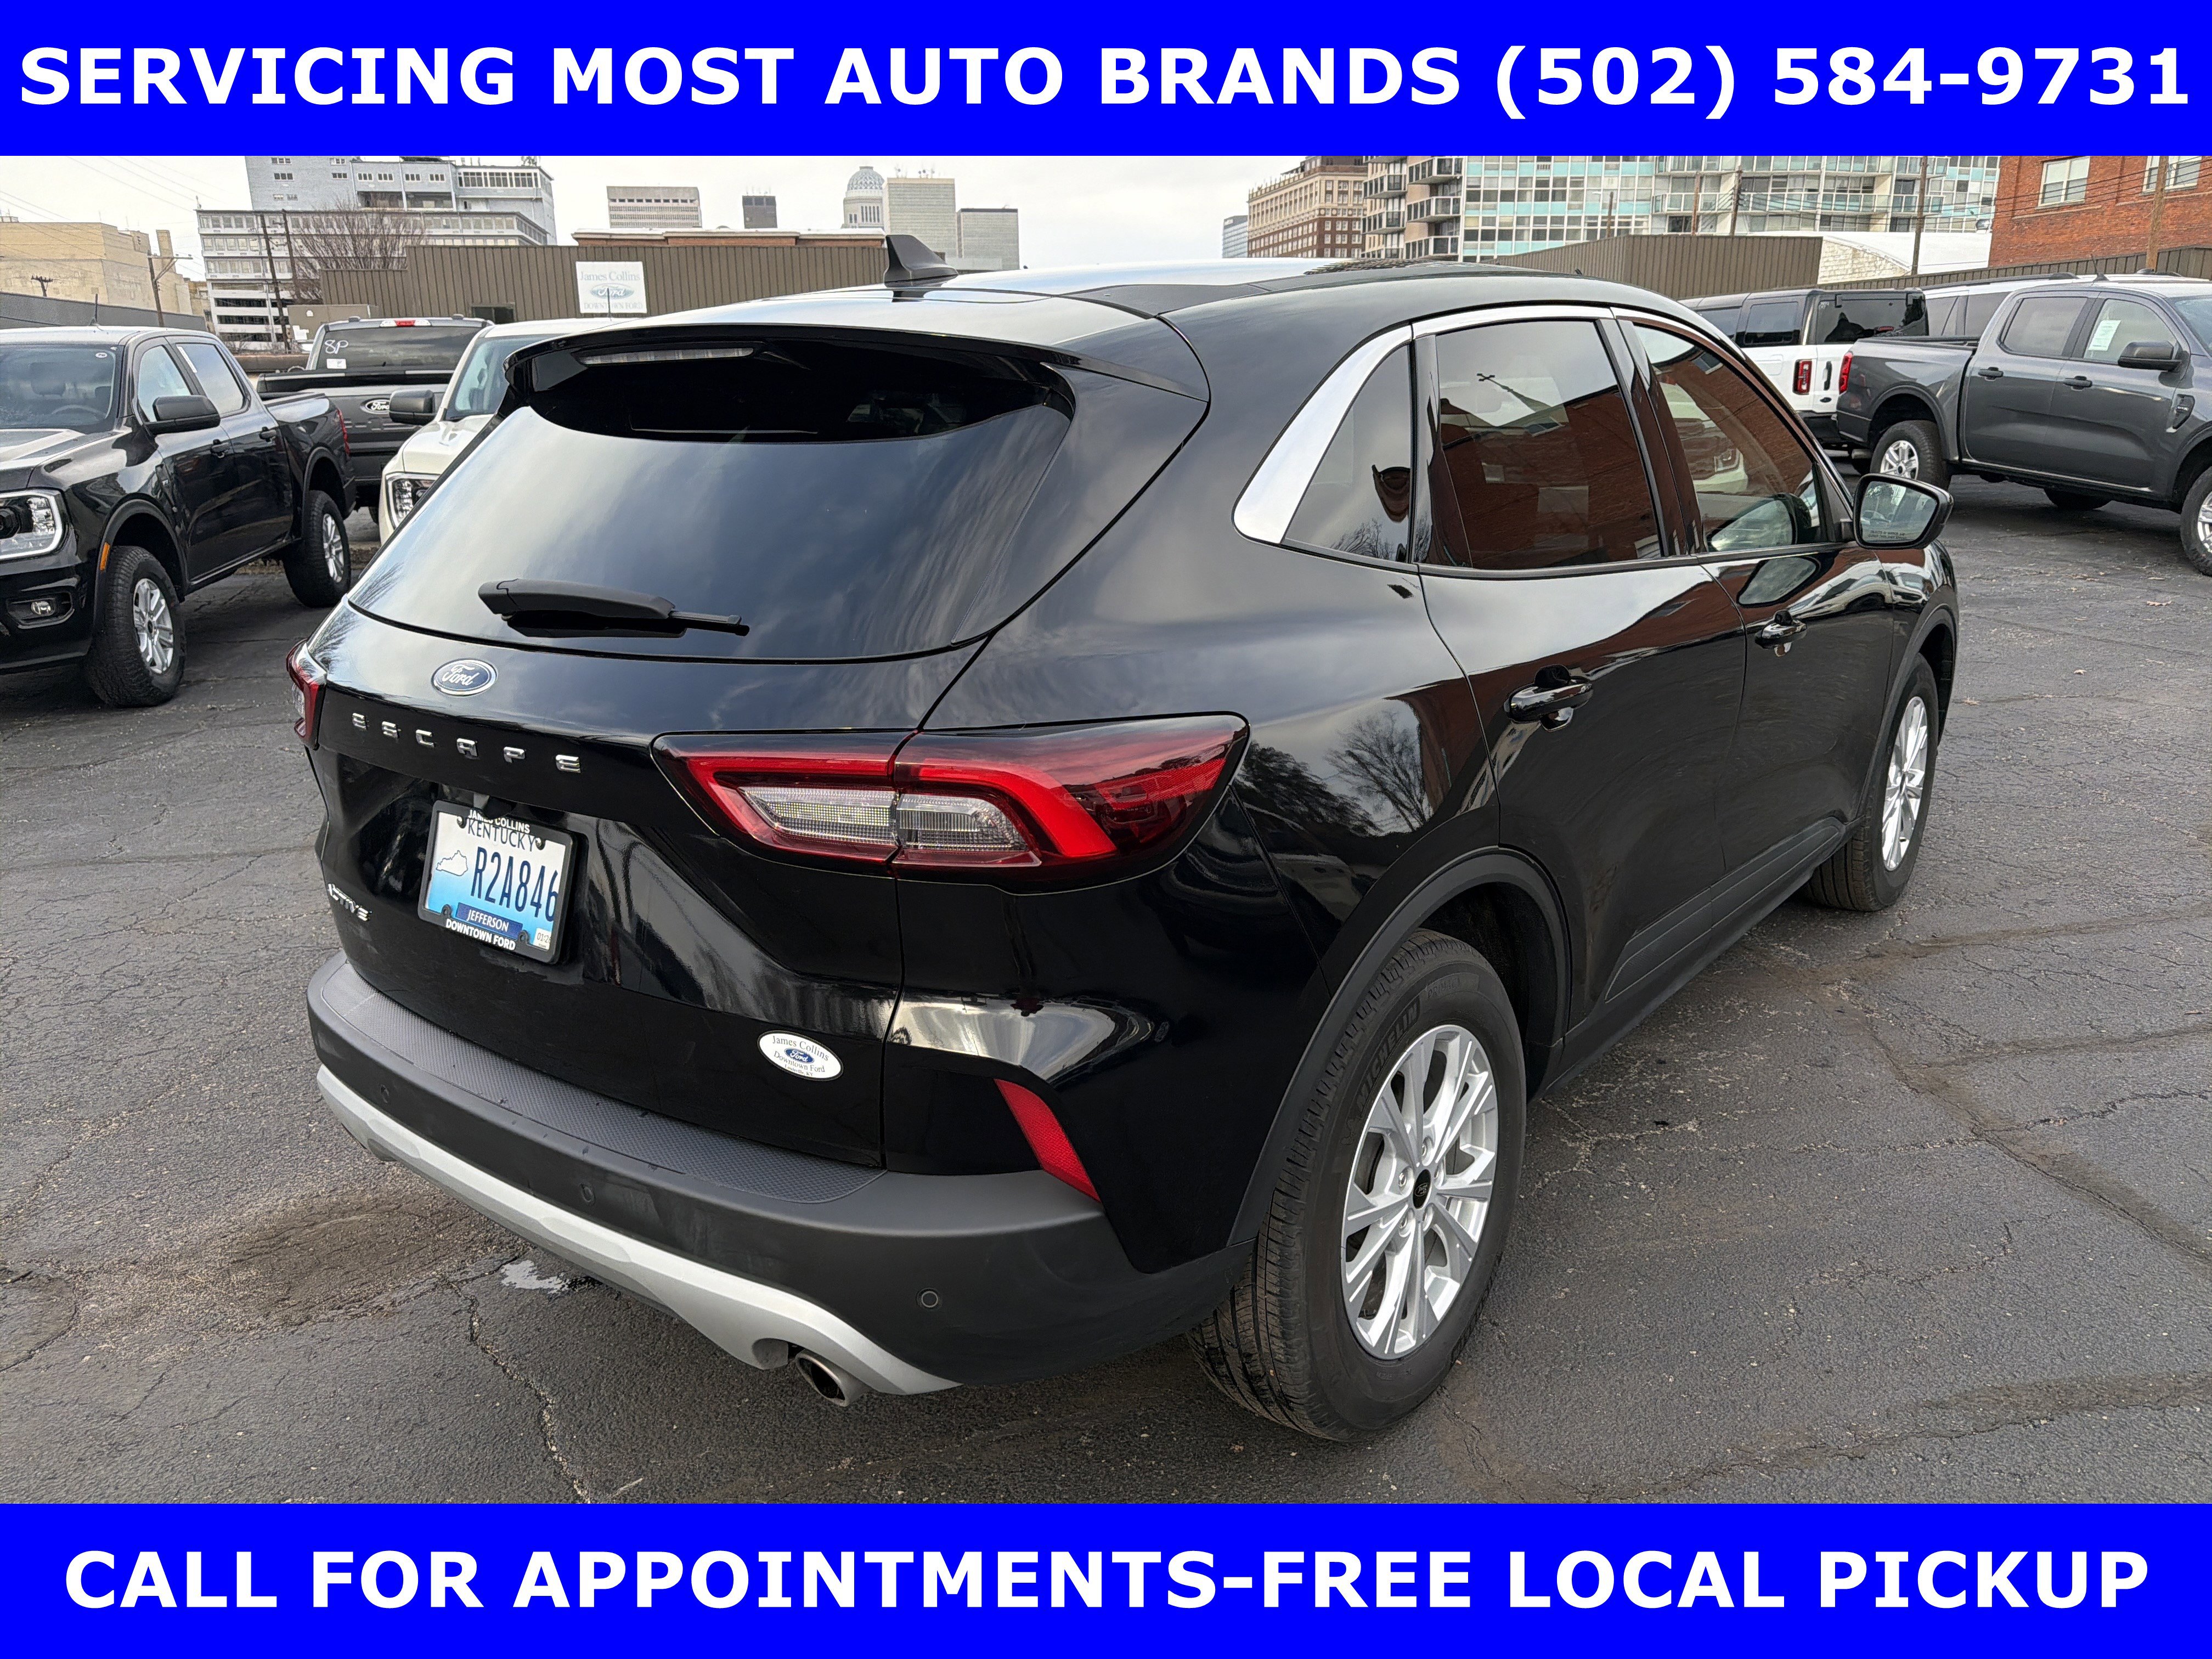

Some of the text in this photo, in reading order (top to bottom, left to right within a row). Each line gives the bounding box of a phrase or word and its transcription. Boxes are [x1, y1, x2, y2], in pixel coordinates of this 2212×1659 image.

[580, 271, 640, 281] James Collins
[442, 664, 480, 686] Ford
[352, 713, 582, 774] ESCAPE
[468, 809, 530, 833] JAM COLLINS
[467, 818, 536, 851] KENTUCKY
[471, 846, 558, 922] R2A846
[467, 910, 509, 933] JEFFERSON
[446, 918, 516, 950] DOWNTOWN FORD
[772, 1035, 829, 1061] James Collins
[789, 1049, 809, 1062] Ford
[774, 1051, 825, 1073] Downtown Ford
